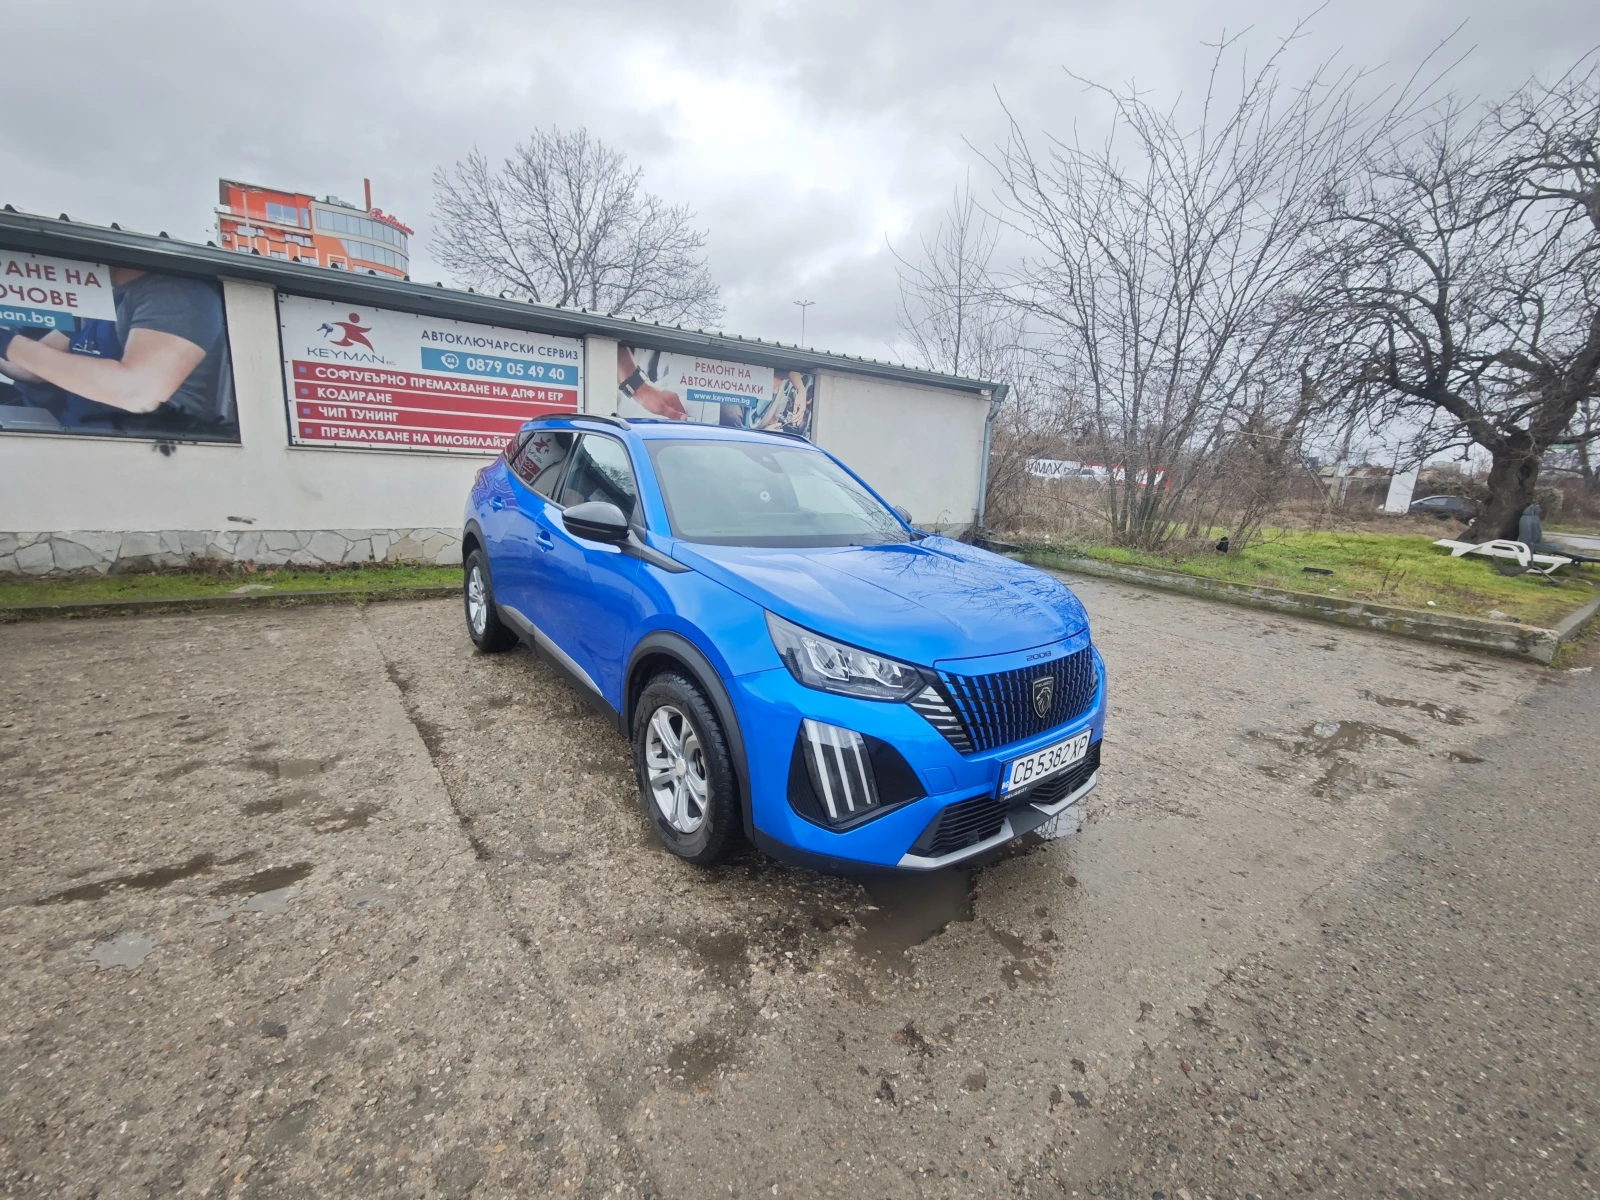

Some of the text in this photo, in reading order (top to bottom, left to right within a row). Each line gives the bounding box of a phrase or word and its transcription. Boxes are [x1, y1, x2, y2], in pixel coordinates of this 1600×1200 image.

[0, 260, 102, 288] АНЕ НА
[421, 330, 578, 360] АВТОКЛЮЧАРСКИ СЕРВИЗ
[307, 346, 385, 364] KEYMAN
[466, 357, 565, 381] 0879 05 49 40
[695, 362, 751, 379] РЕМОНТ НА
[315, 367, 563, 402] СОФТУЕЪРНО ПРЕМАХВАНЕ НА ДПФ И ЕГР
[679, 374, 764, 395] АВТОКЛЮЧАЛКИ
[317, 387, 393, 403] КОДИРАНЕ
[693, 392, 751, 406] www.keyman.bg
[318, 406, 399, 422] ЧИП ТУНИНГ
[321, 426, 410, 442] ПРЕМАХВАНЕ
[412, 433, 431, 444] НА
[1026, 650, 1052, 662] 2008
[1035, 743, 1071, 776] 5382
[1003, 786, 1028, 800] PEUGEOT
